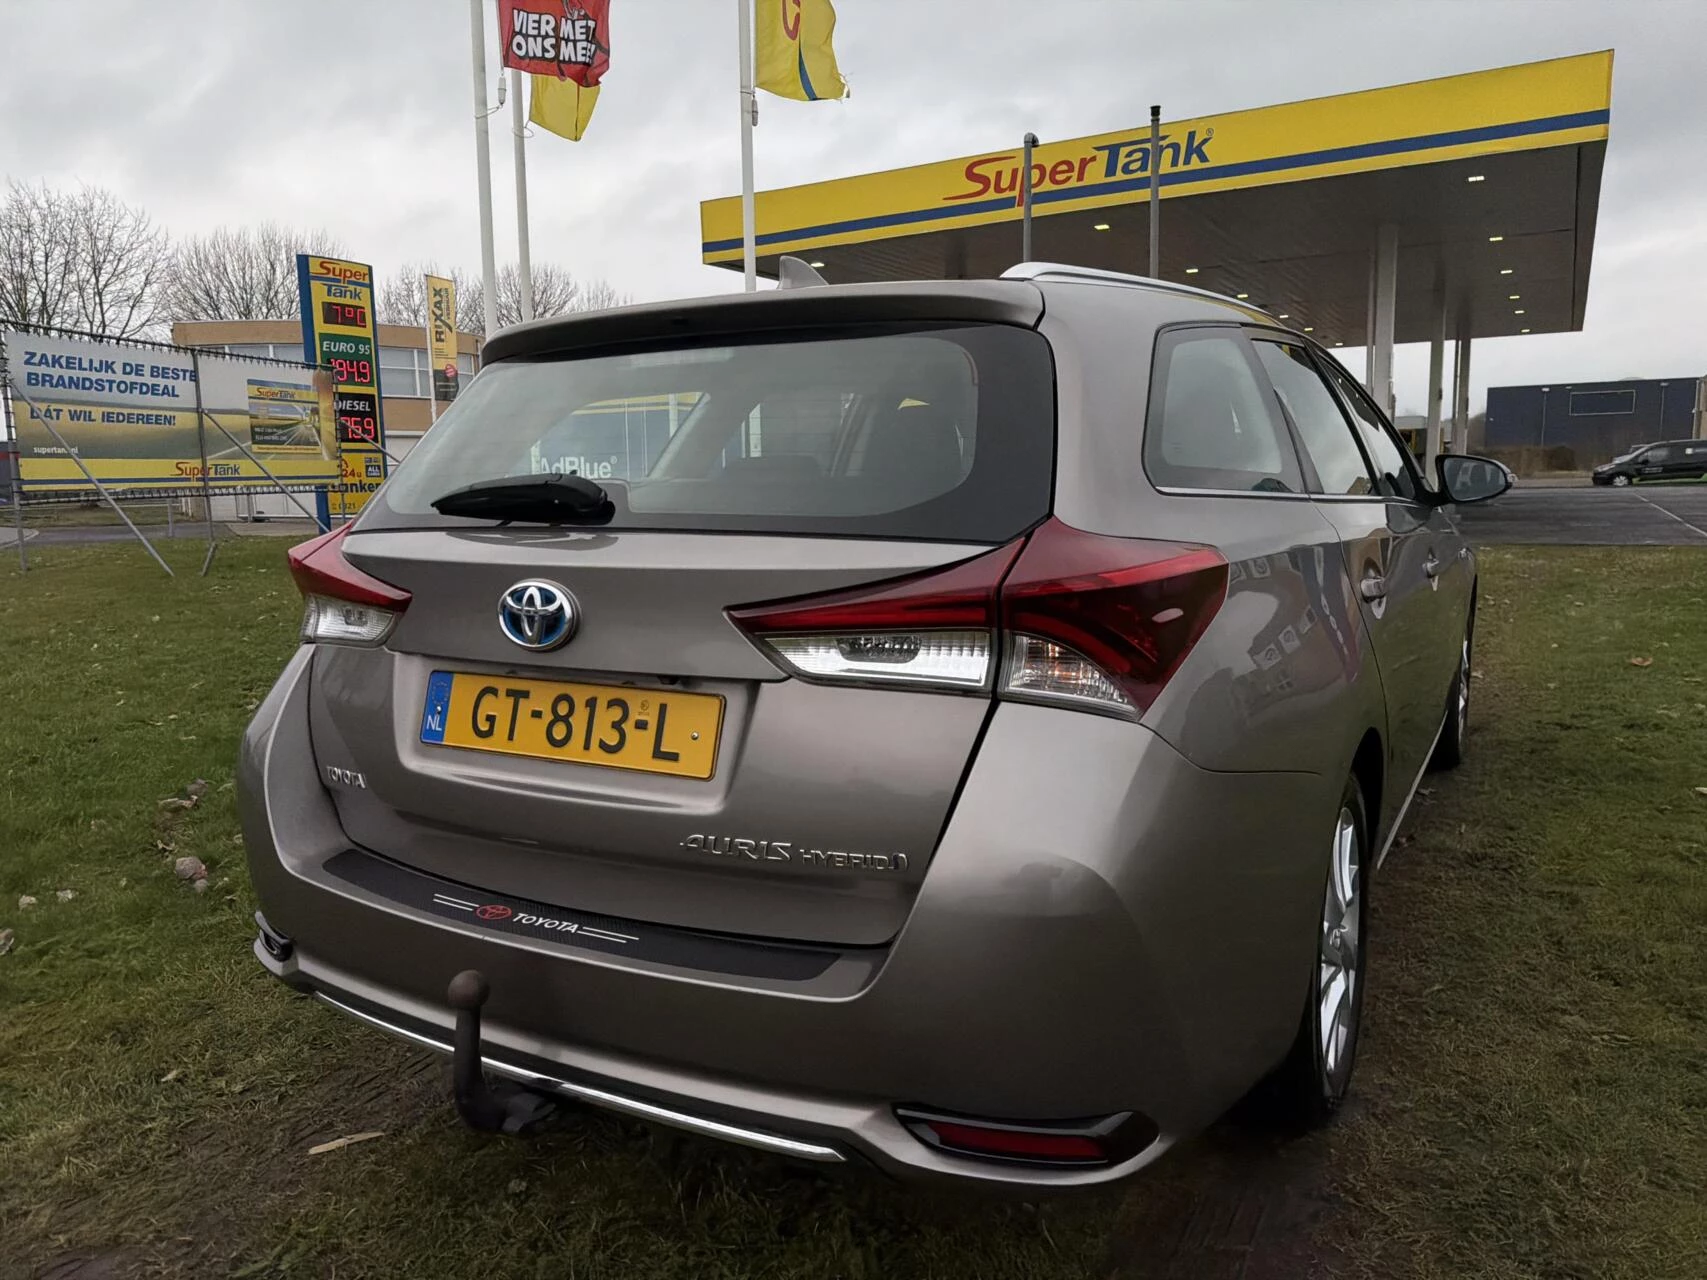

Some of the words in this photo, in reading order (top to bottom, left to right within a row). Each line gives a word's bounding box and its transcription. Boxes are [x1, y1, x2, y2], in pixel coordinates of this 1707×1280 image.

[513, 9, 555, 36] VIER
[560, 18, 596, 41] MET
[512, 34, 555, 58] ONS
[942, 130, 1213, 207] SuperTank
[311, 261, 368, 284] Super
[321, 283, 362, 301] Tank
[322, 341, 355, 352] EURO
[358, 344, 370, 354] 95
[24, 351, 117, 374] ZAKELIJK
[122, 362, 145, 377] DE
[150, 366, 197, 382] BESTE
[26, 372, 179, 397] BRANDSTOFDEAL
[333, 400, 371, 411] DIESEL
[68, 409, 96, 422] WIL
[101, 411, 176, 426] IEDEREEN!
[541, 456, 612, 479] AdBlue
[426, 714, 443, 731] NL
[471, 686, 680, 762] GT-813-L
[680, 834, 792, 861] AURIS
[800, 849, 890, 870] HYBRID
[513, 913, 578, 933] TOYOTA
